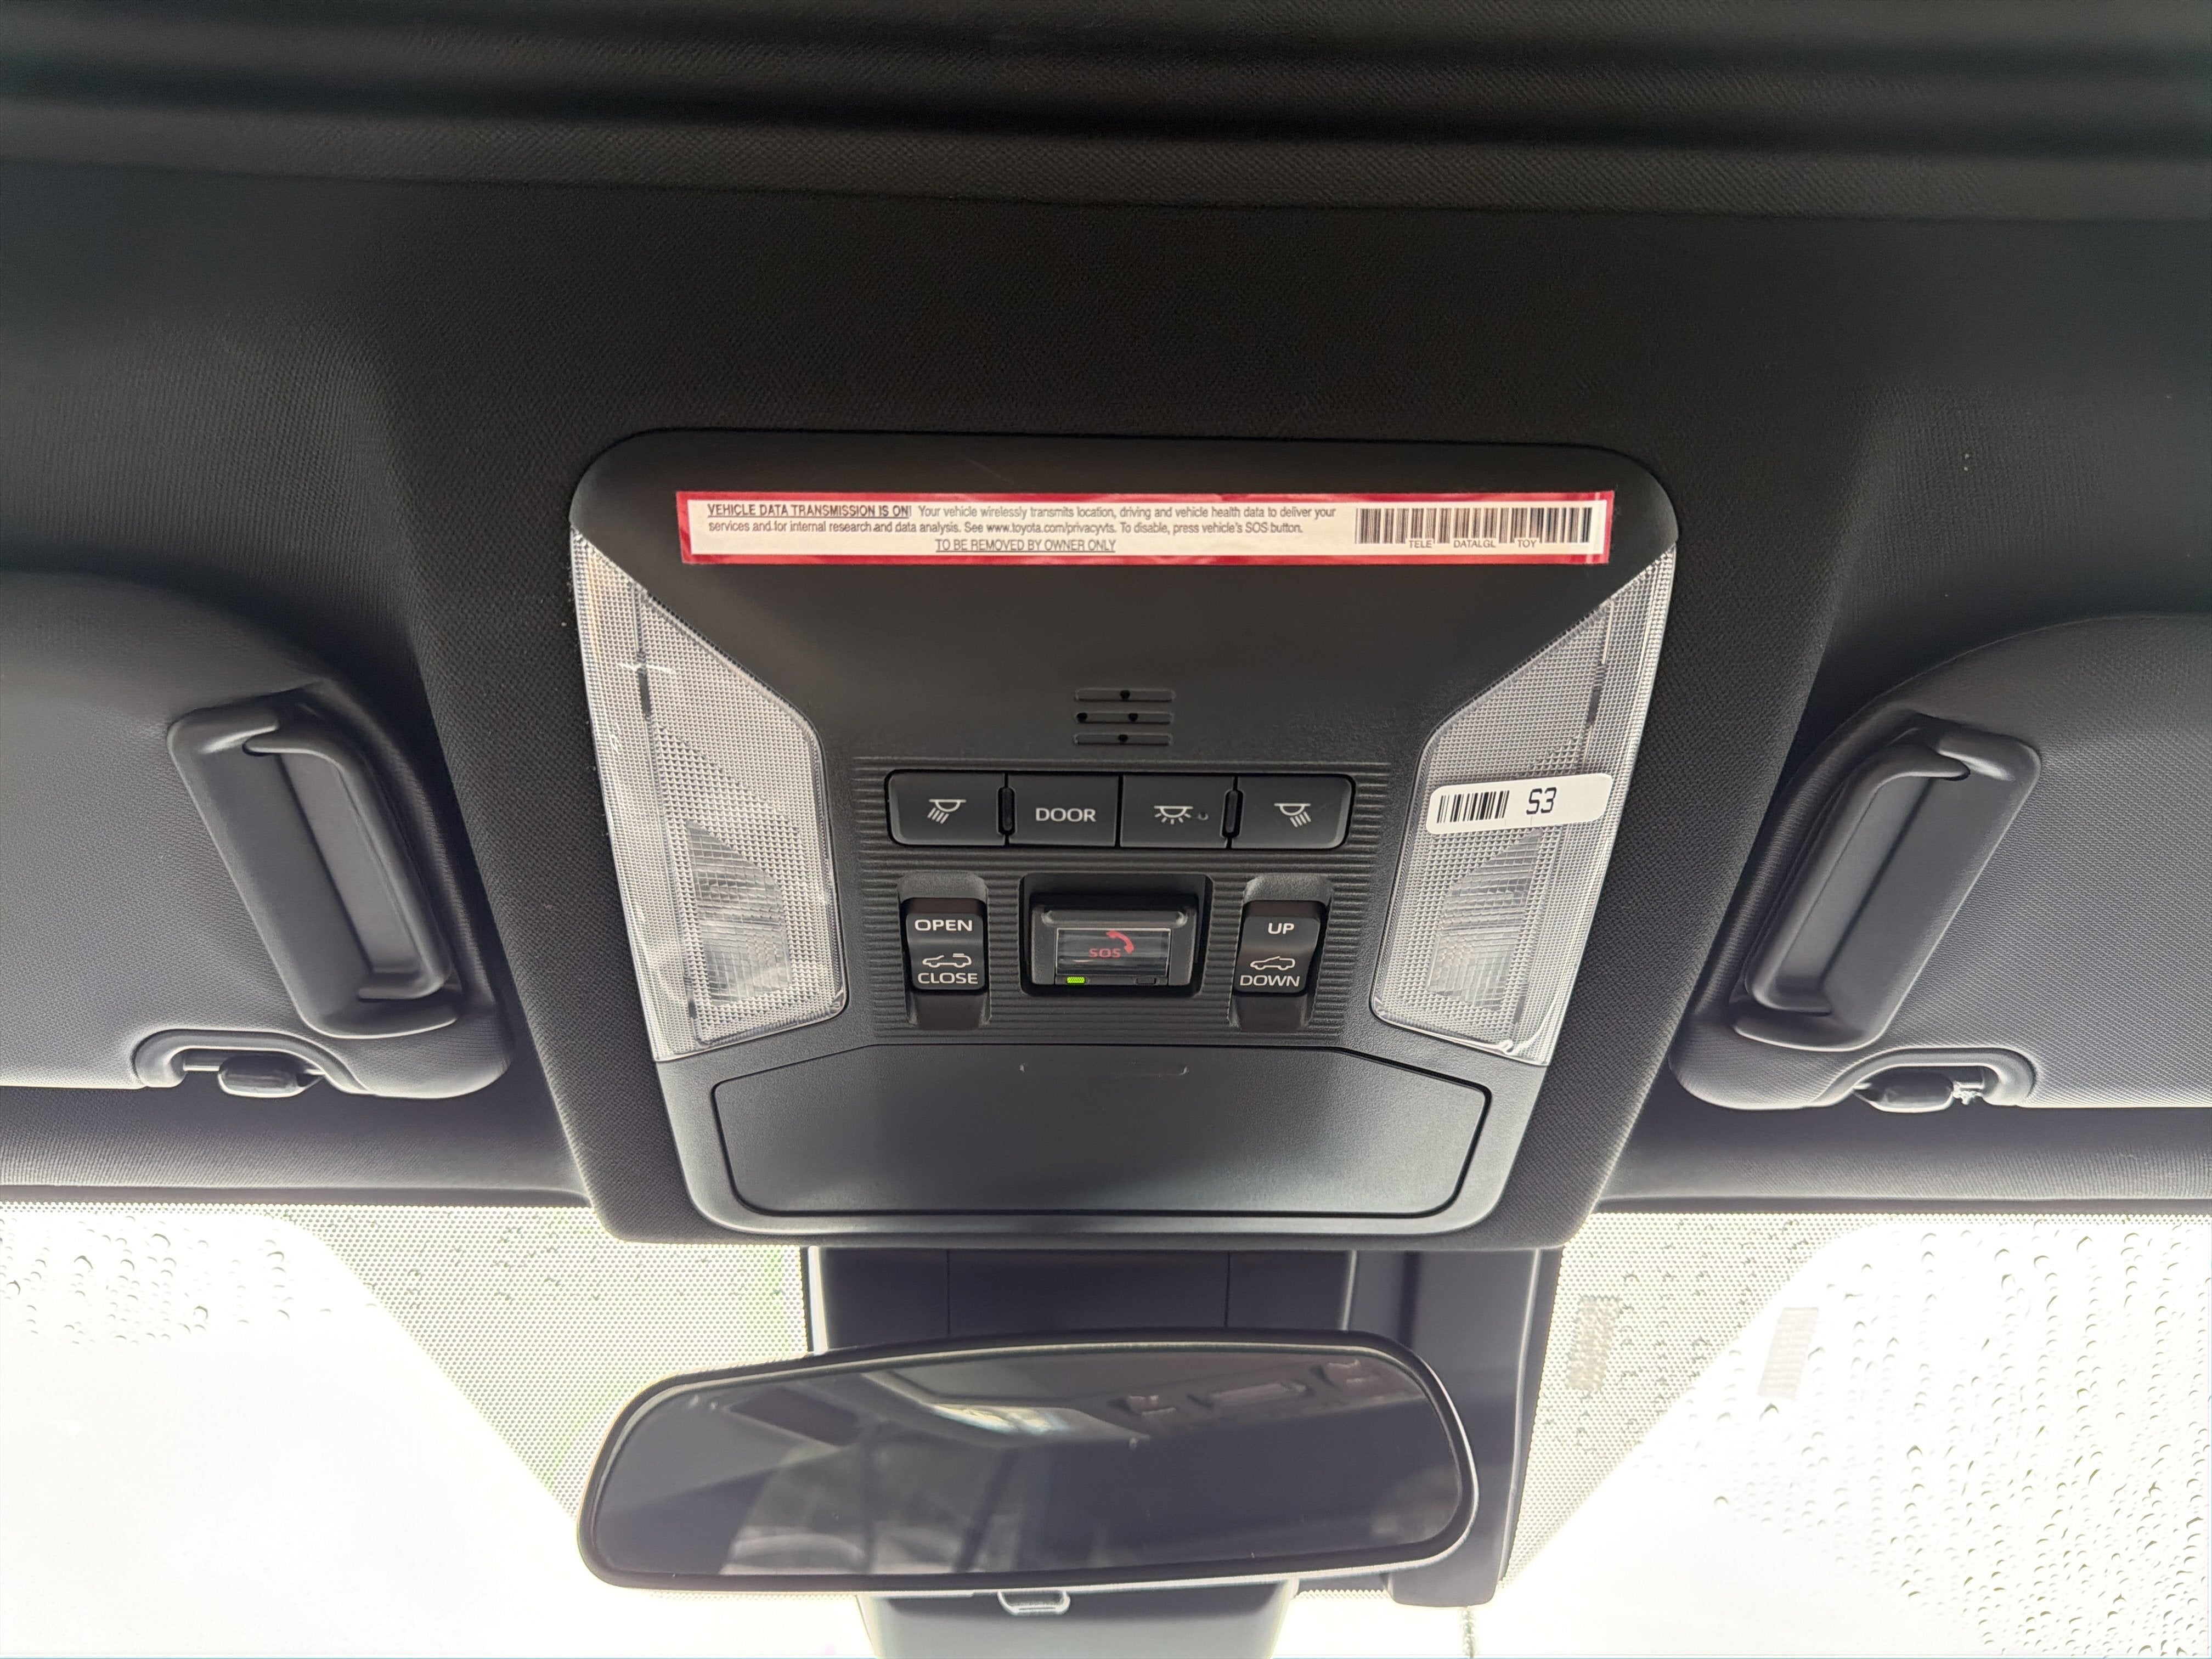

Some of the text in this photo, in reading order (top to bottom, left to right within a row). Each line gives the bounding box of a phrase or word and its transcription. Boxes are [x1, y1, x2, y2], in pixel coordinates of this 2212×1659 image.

[707, 504, 756, 516] VEHICLE
[760, 504, 788, 516] DATA
[791, 505, 876, 517] TRANSMISSION
[879, 505, 889, 517] IS
[918, 505, 940, 517] Your
[943, 505, 977, 517] vehicle
[981, 506, 1027, 520] wirelessly
[1030, 506, 1074, 517] transmits
[1077, 506, 1117, 520] location,
[1120, 506, 1151, 520] driving
[1154, 506, 1172, 518] and
[1175, 506, 1208, 518] vehicle
[1211, 506, 1241, 518] health
[1243, 506, 1265, 518] data
[1268, 507, 1277, 518] to
[1279, 507, 1312, 518] deliver
[1314, 508, 1336, 520] your
[709, 521, 1304, 536] services and for internal research and data analysis. See www.toyota.com/privacyvts. To disable, press vehicle's SOS button.
[935, 539, 1116, 552] TO BE REMOVED BY OWNER ONLY
[1408, 540, 1432, 549] TELE
[1517, 539, 1537, 548] TOY
[1526, 786, 1557, 815] S3
[1035, 807, 1096, 822] DOOR
[914, 919, 973, 932] OPEN
[1267, 923, 1295, 934] UP
[1088, 948, 1121, 958] SOS
[917, 973, 978, 984] CLOSE
[1240, 975, 1300, 987] DOWN
